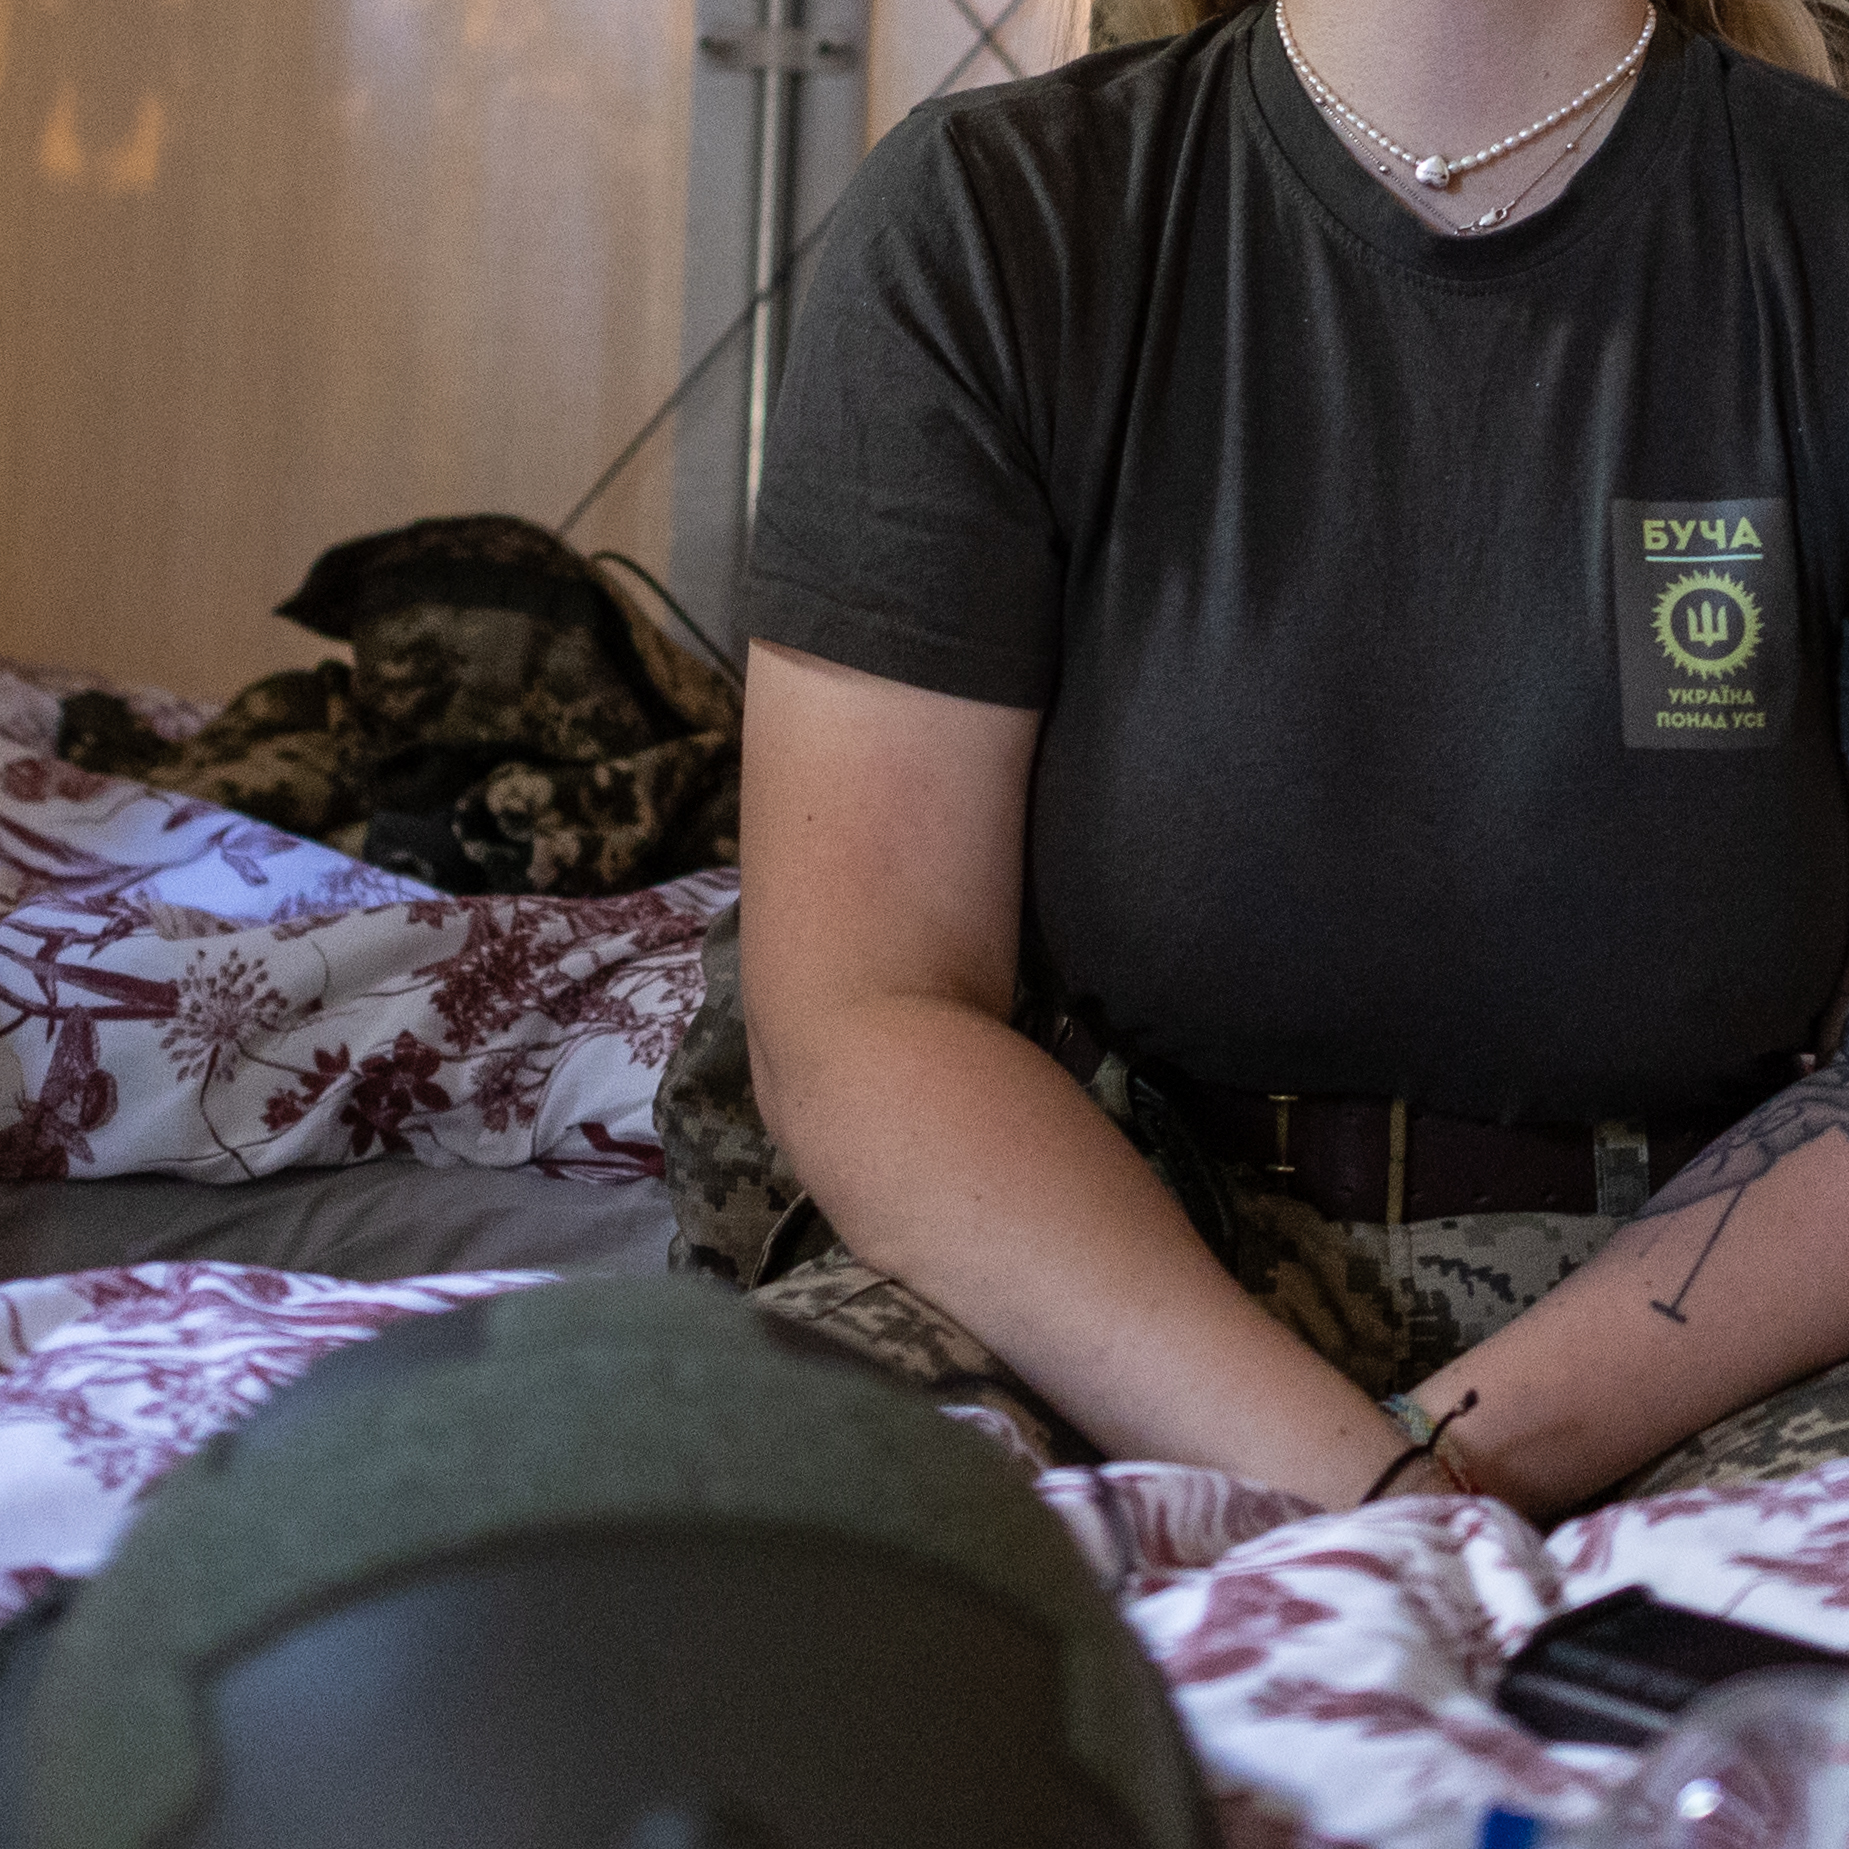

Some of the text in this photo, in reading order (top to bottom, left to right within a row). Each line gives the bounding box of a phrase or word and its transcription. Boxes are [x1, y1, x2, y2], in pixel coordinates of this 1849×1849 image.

[1643, 516, 1763, 551] БУЧА
[1668, 685, 1755, 706] УКРАЇНА
[1656, 710, 1766, 730] ПОНАД УСЕ
